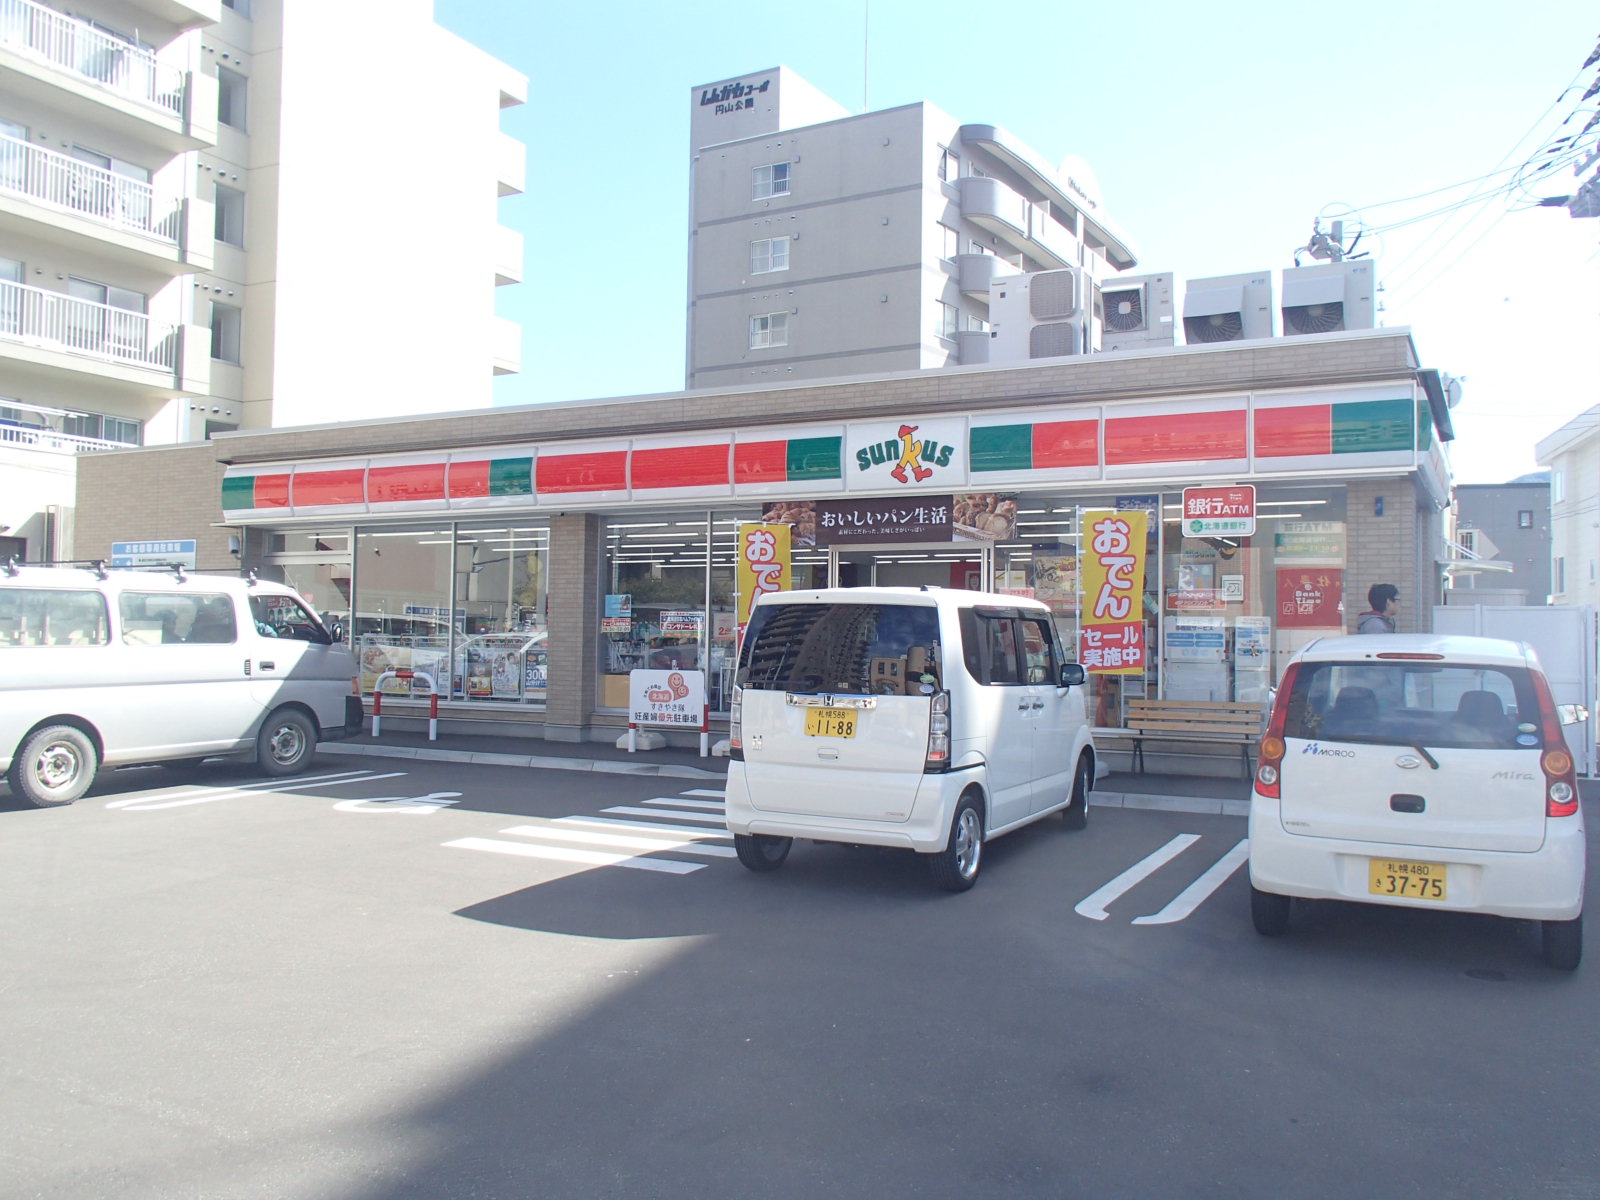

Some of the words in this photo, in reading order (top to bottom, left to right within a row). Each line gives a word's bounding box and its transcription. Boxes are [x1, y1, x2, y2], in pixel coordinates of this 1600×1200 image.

[715, 97, 753, 115] 円山公園
[821, 506, 948, 527] おいしいパン生活
[1204, 521, 1247, 530] 北海道銀行
[1093, 518, 1136, 620] おでん
[1084, 626, 1139, 647] セール
[1084, 646, 1140, 667] 実施中
[635, 712, 698, 723] 妊産婦優先駐車場
[817, 720, 853, 736] 11-88
[1492, 771, 1535, 780] Mira
[1386, 875, 1442, 897] 37-75
